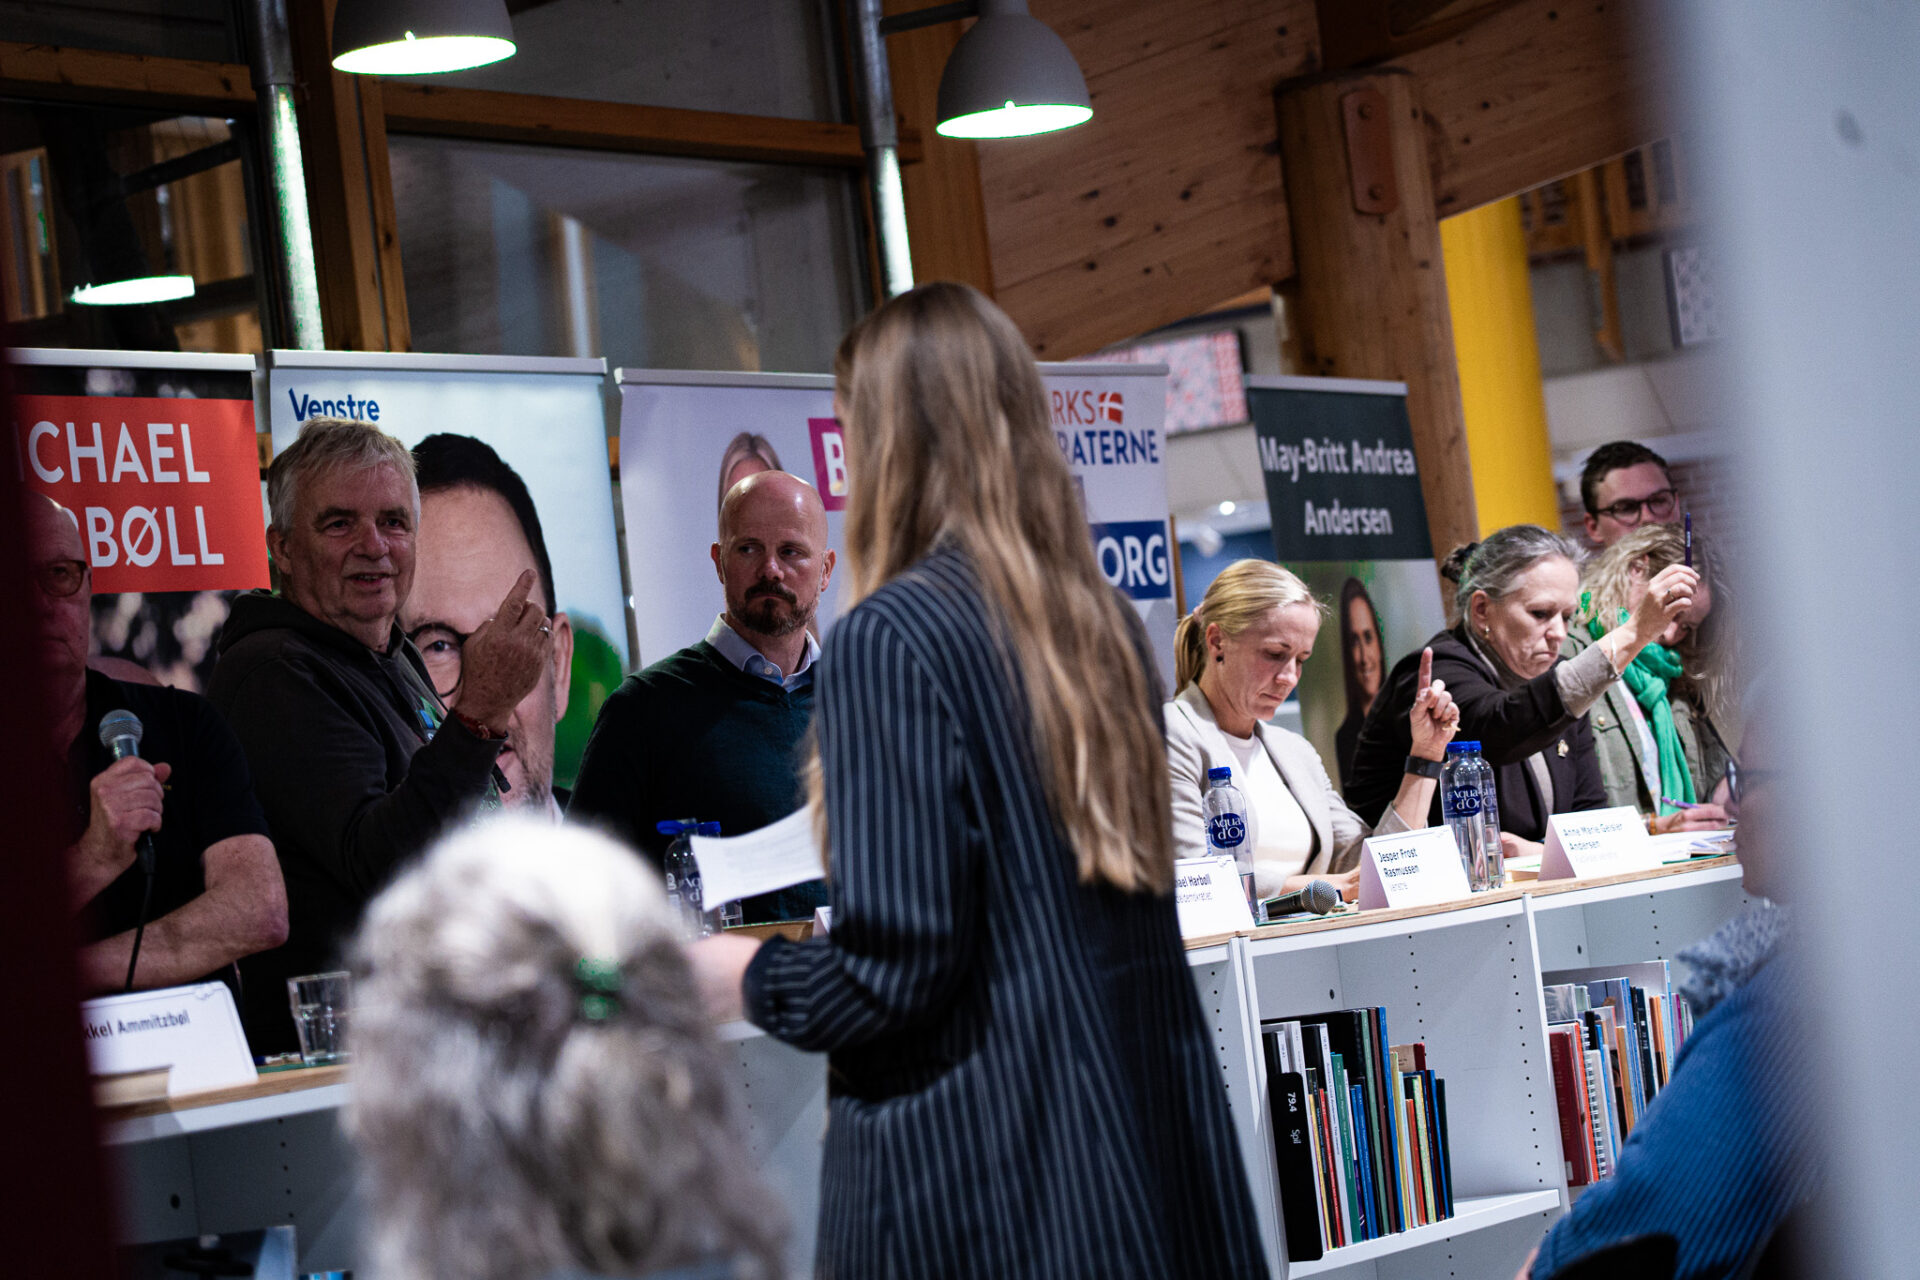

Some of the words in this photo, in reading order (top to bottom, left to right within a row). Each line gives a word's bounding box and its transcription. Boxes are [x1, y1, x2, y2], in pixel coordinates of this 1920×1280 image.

[288, 387, 380, 422] Venstre
[1047, 389, 1097, 425] RKS
[1260, 436, 1349, 483] May-Britt
[1352, 438, 1416, 475] Andrea
[1304, 498, 1393, 536] Andersen
[63, 505, 224, 568] BØLL
[1096, 533, 1168, 588] ORG
[1378, 850, 1399, 863] Jesper
[1399, 847, 1418, 859] Frost
[1383, 865, 1420, 878] Rasmussen
[1287, 1091, 1298, 1113] 79.4
[1290, 1128, 1302, 1144] Spil
